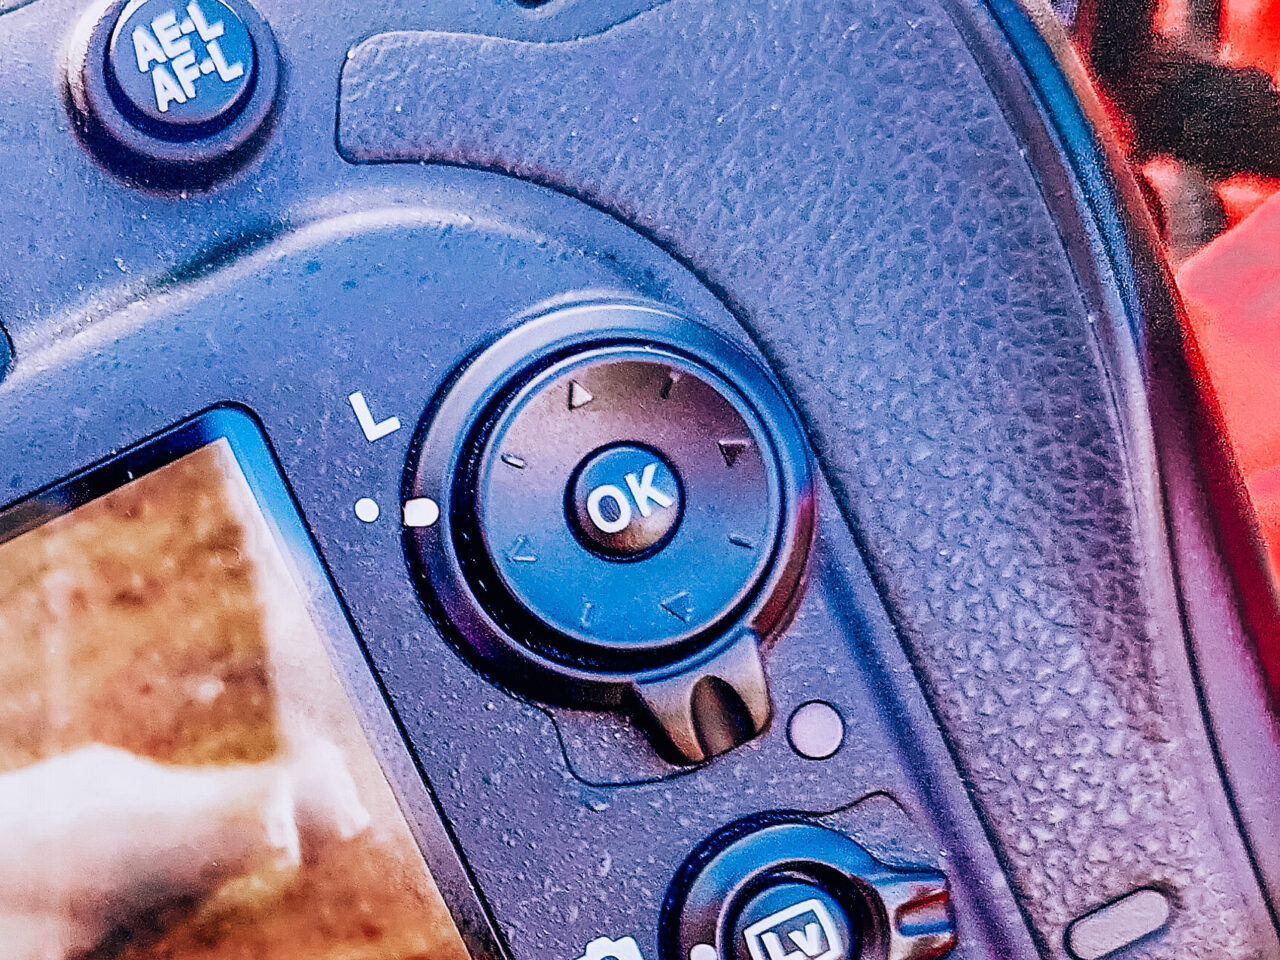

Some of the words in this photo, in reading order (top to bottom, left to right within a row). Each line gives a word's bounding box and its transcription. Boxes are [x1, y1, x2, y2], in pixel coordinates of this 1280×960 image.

[132, 0, 226, 72] AE-L
[150, 40, 246, 113] AF-L
[349, 390, 401, 442] L
[585, 463, 673, 532] OK
